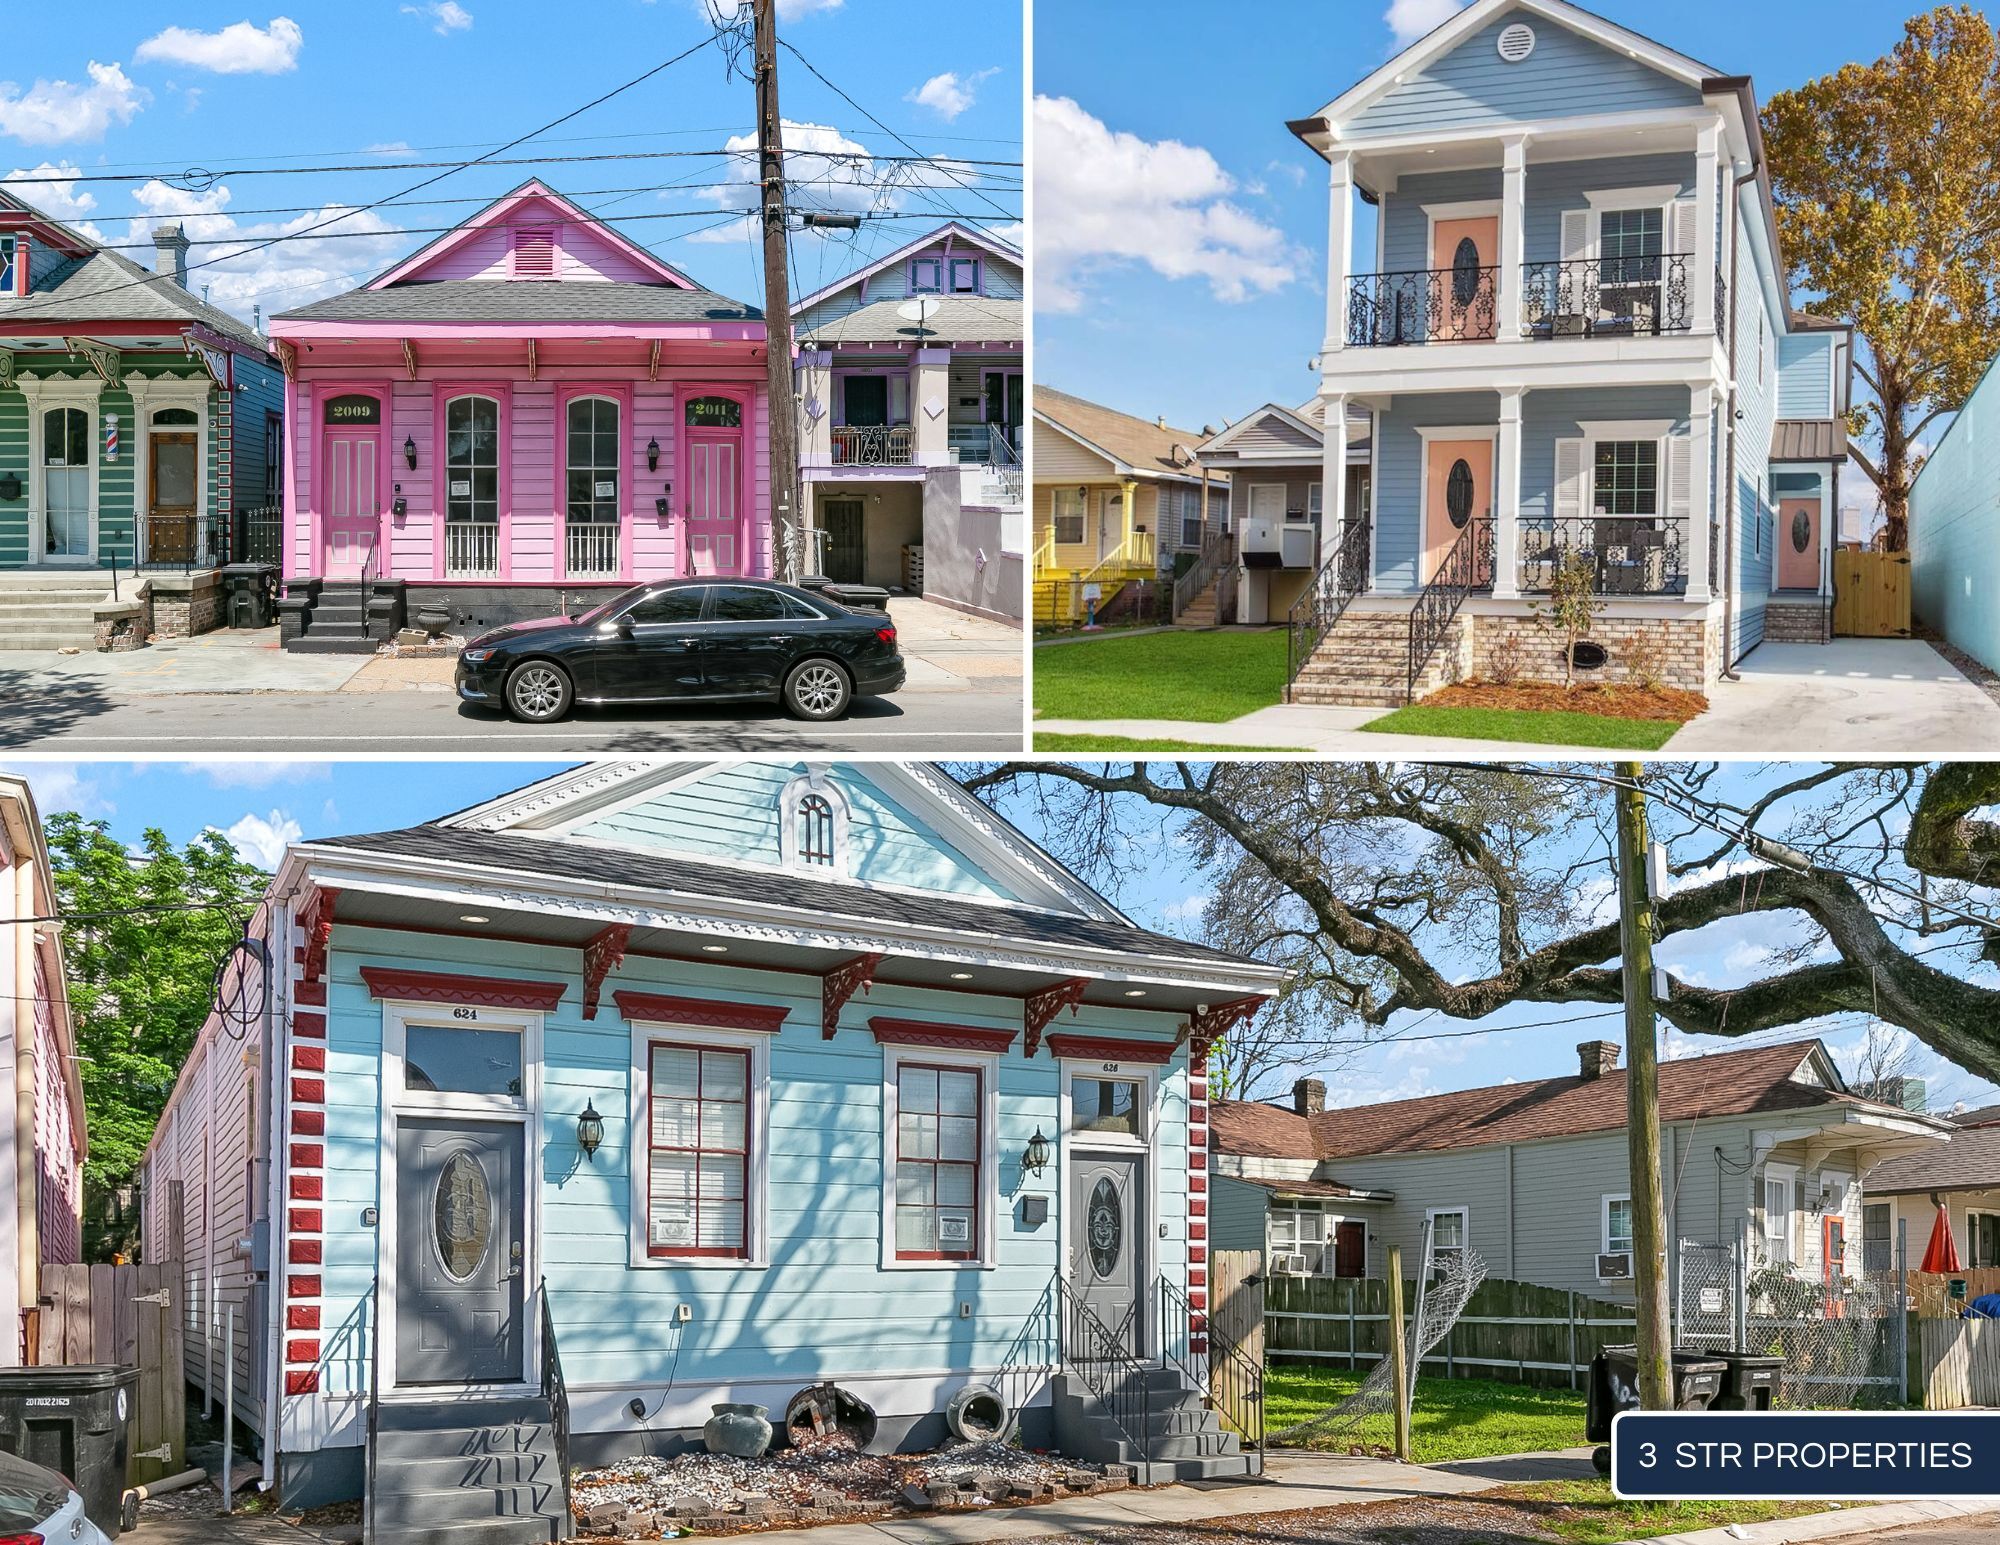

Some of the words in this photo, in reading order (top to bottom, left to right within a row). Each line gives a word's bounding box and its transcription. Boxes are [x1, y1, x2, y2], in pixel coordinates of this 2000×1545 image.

[333, 405, 371, 417] 2009
[695, 403, 726, 416] 2011
[453, 1008, 478, 1021] 624
[1103, 1063, 1119, 1073] 626
